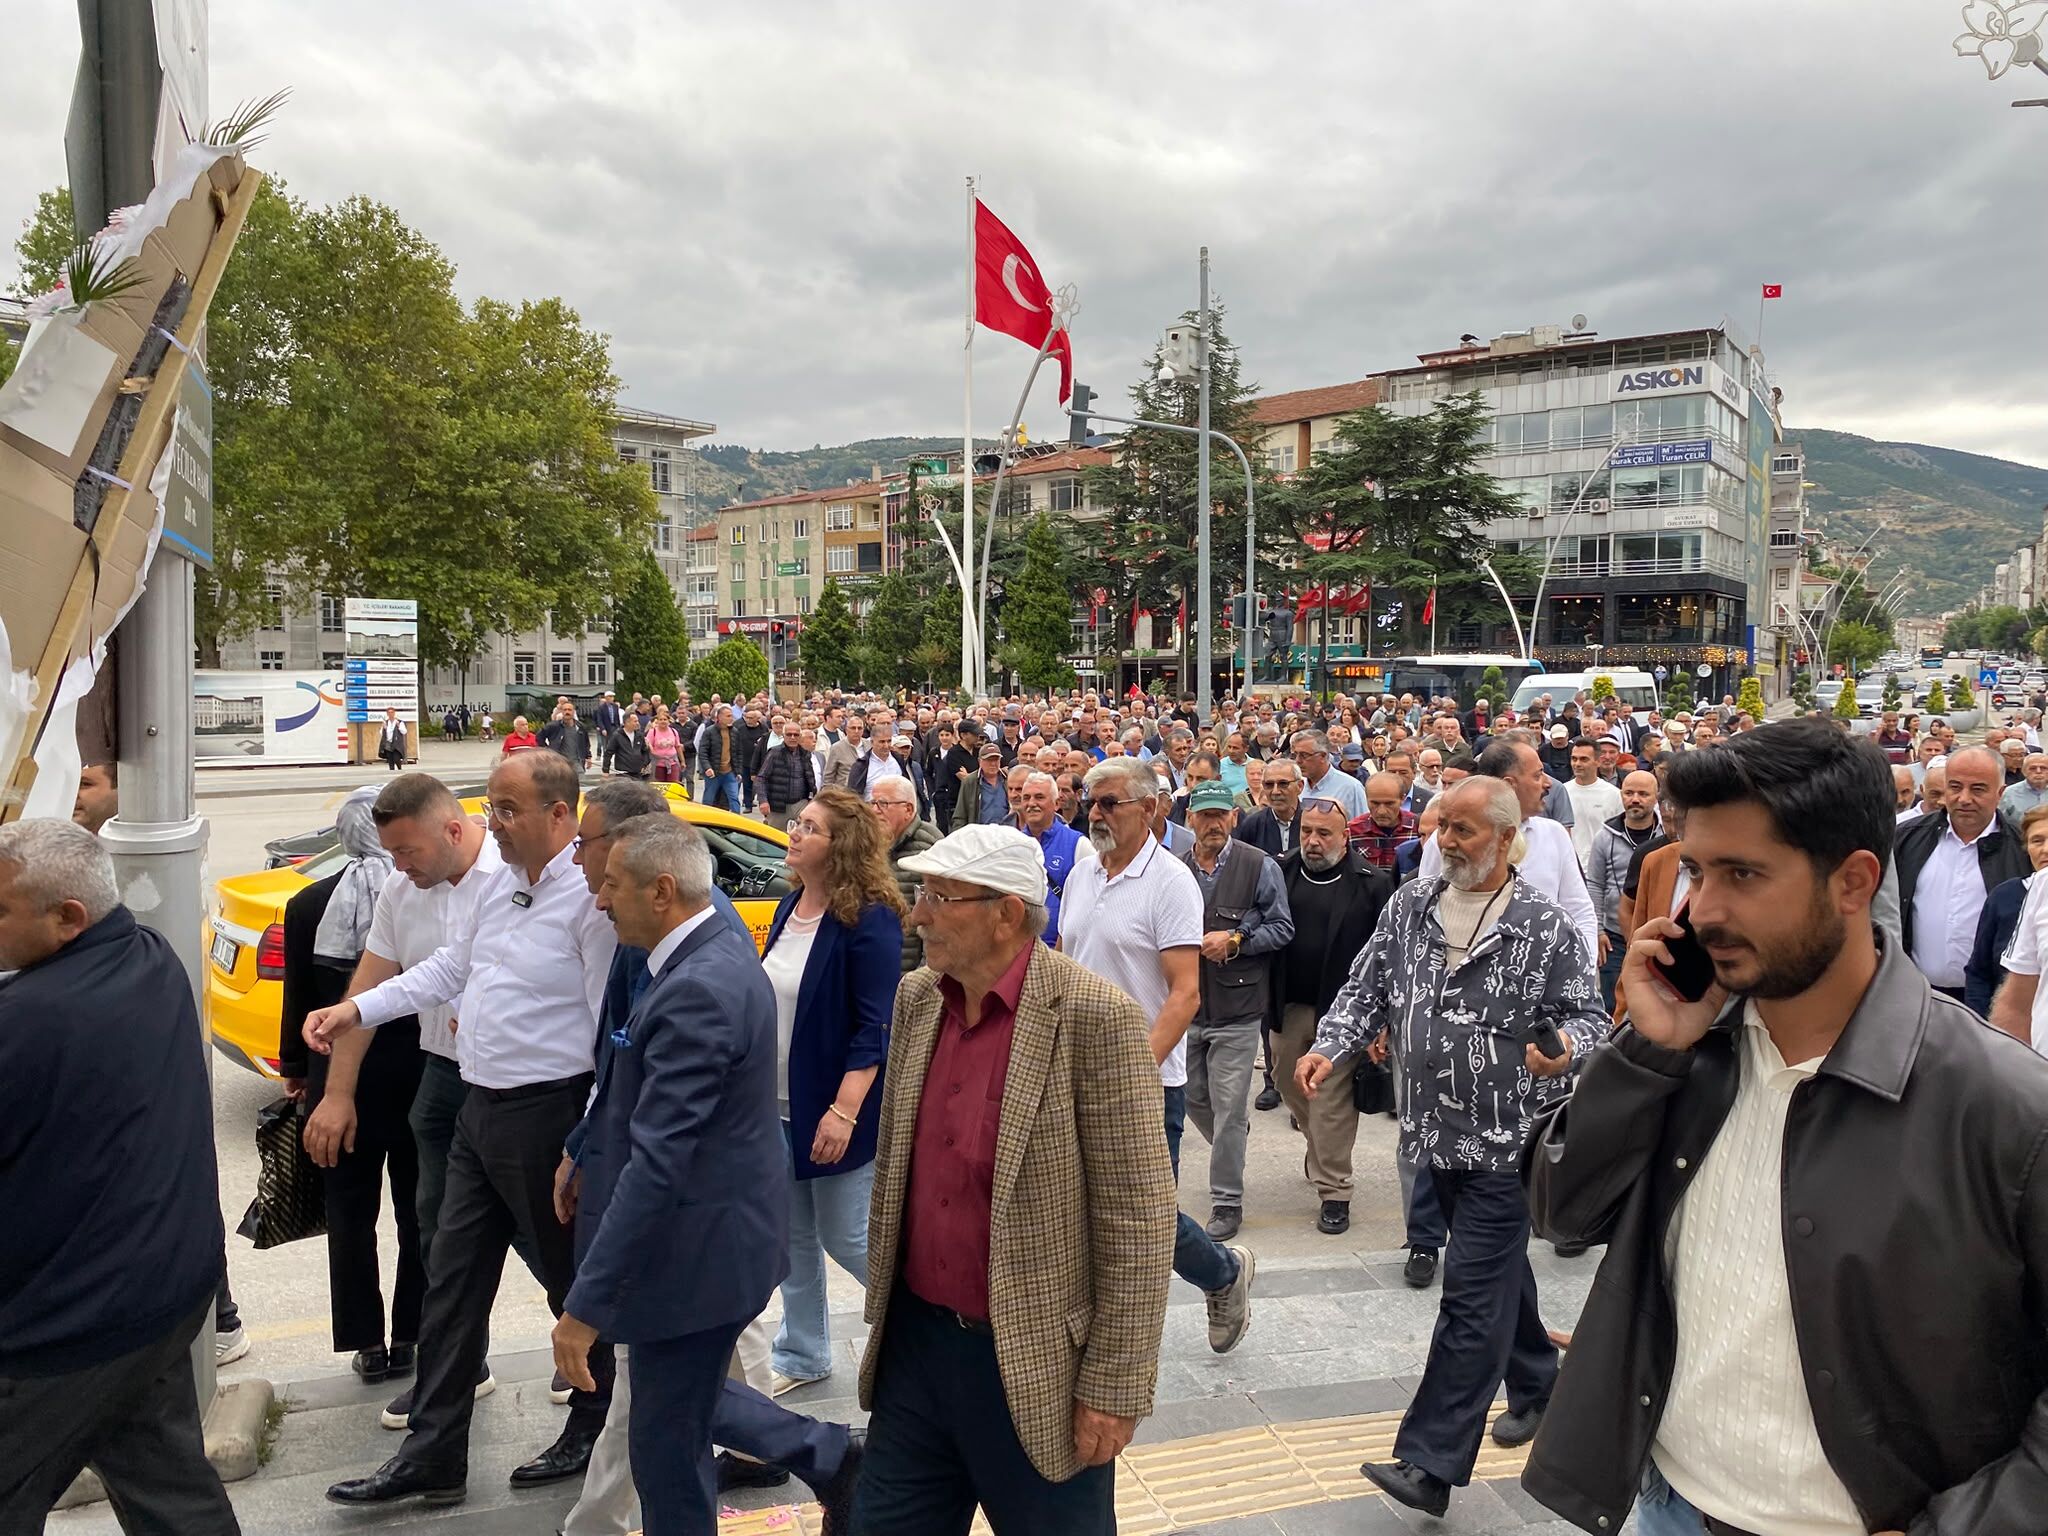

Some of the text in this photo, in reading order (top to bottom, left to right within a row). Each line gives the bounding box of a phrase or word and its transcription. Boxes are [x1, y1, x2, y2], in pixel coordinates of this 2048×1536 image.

[1617, 366, 1703, 392] ASKON
[1632, 455, 1654, 465] ÇELİK
[1684, 451, 1706, 461] ÇELİK
